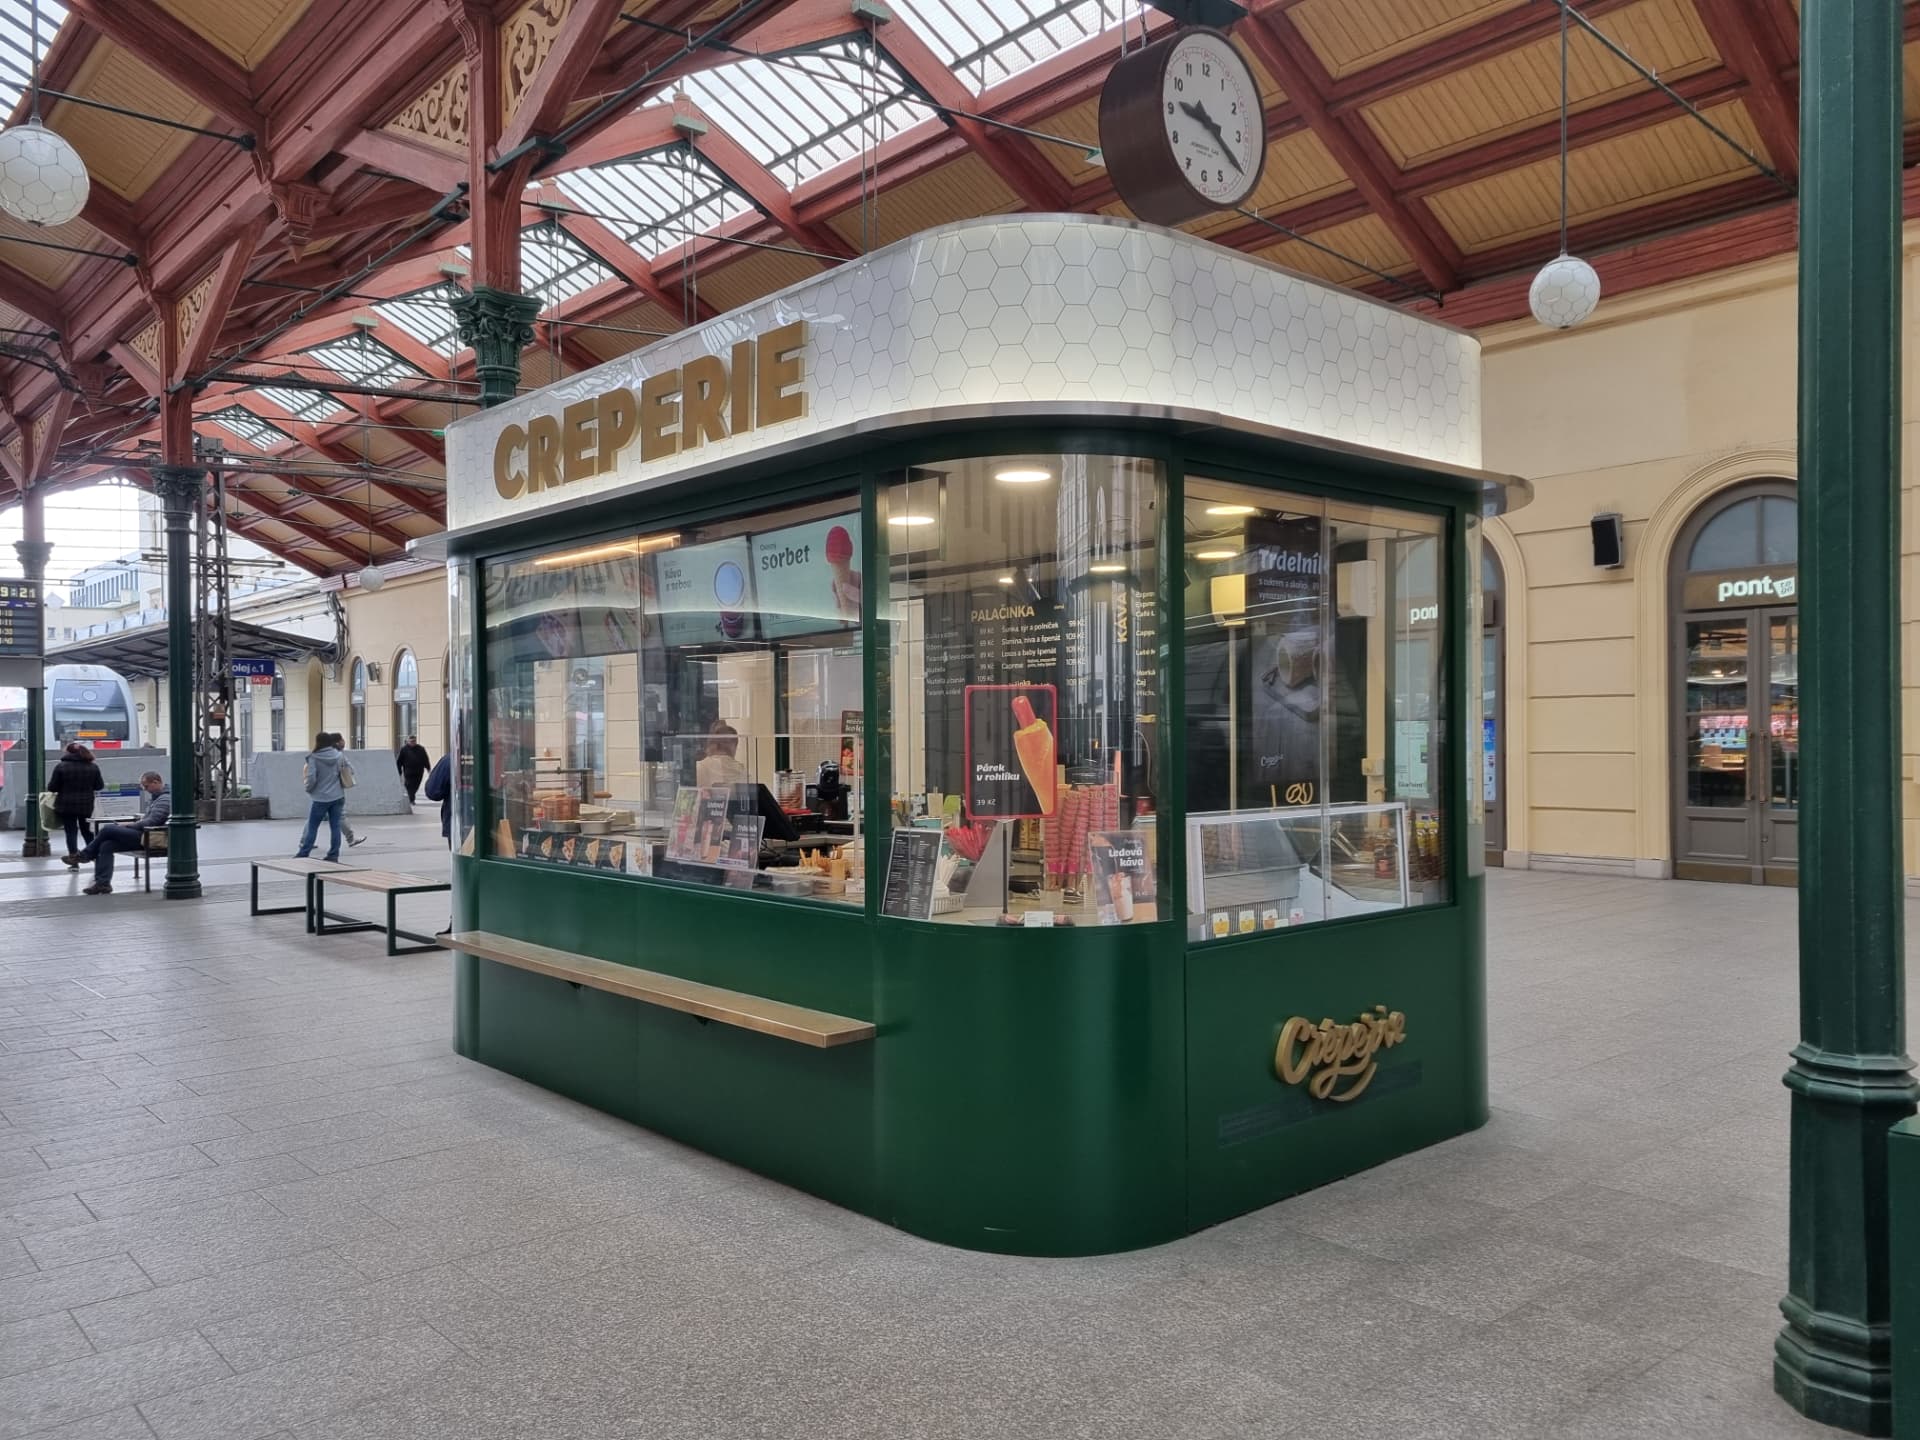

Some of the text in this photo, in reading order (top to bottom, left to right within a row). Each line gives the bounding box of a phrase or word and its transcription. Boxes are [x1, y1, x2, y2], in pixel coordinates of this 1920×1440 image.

[1186, 63, 1192, 76] 11
[1202, 63, 1210, 77] 12
[1174, 77, 1183, 92] 10
[1220, 79, 1224, 91] 1
[1168, 102, 1174, 114] 9
[1232, 102, 1237, 115] 2
[1172, 130, 1179, 144] 8
[1235, 131, 1241, 143] 3
[1185, 157, 1192, 170] 7
[1201, 170, 1208, 183] 6
[1217, 170, 1224, 183] 5
[494, 320, 809, 500] CREPERIE
[761, 545, 810, 570] sorbet
[1718, 576, 1774, 602] pont
[971, 604, 1035, 622] PALAČINKA
[231, 663, 251, 674] olej
[976, 763, 1005, 773] Párek
[985, 772, 1020, 781] rohlíku
[1108, 847, 1143, 858] Ledová
[1119, 857, 1144, 867] káva
